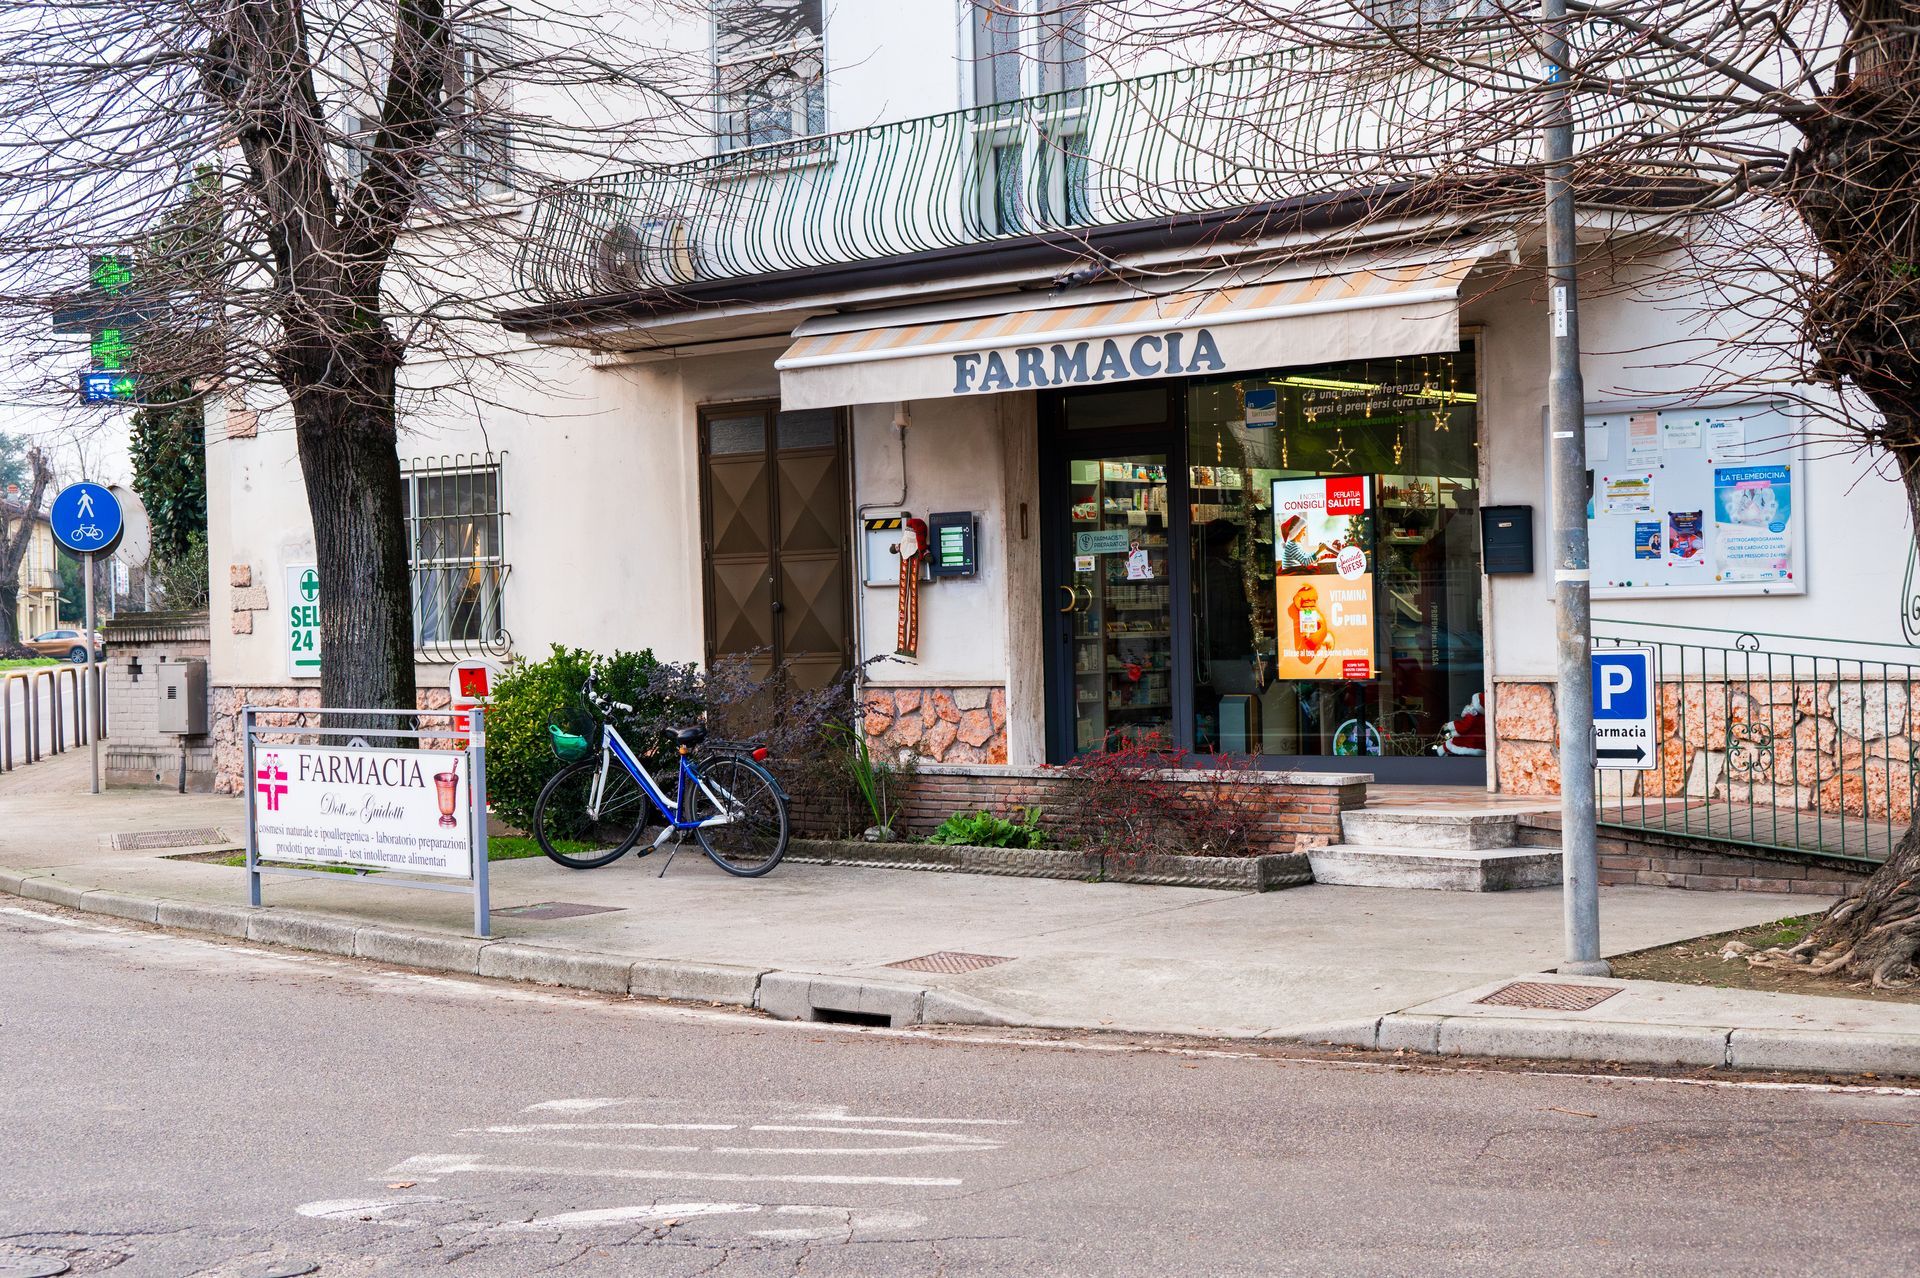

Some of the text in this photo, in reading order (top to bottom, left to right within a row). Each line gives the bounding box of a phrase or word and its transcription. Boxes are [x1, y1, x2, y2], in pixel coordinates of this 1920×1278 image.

[953, 328, 1226, 394] FARMACIA
[1319, 391, 1337, 400] una
[1336, 404, 1342, 412] e
[1344, 398, 1389, 414] prendersi
[1392, 397, 1413, 408] cura
[1416, 396, 1426, 405] di
[1732, 472, 1786, 481] TELEMEDICINA
[1284, 500, 1325, 510] CONSIGLI
[1328, 498, 1361, 508] SALUTE
[1341, 559, 1364, 575] DIFESE
[1329, 589, 1367, 601] VITAMINA
[1331, 602, 1343, 627] C
[1344, 614, 1367, 626] PURA
[291, 630, 314, 652] 24
[1600, 664, 1633, 710] P
[1595, 725, 1647, 738] armacia
[298, 754, 426, 788] FARMACIA
[360, 793, 404, 825] Guidotti
[258, 823, 285, 835] cosmesi
[286, 825, 312, 838] naturale
[314, 829, 318, 838] e
[320, 826, 369, 845] ipoallergenica
[376, 831, 417, 846] laboratorio
[418, 836, 467, 851] preparazioni
[276, 841, 303, 855] prodotti
[304, 845, 315, 857] per
[317, 844, 343, 858] animali
[349, 849, 362, 859] test
[364, 847, 406, 864] intolleranze
[408, 852, 447, 867] alimentari
